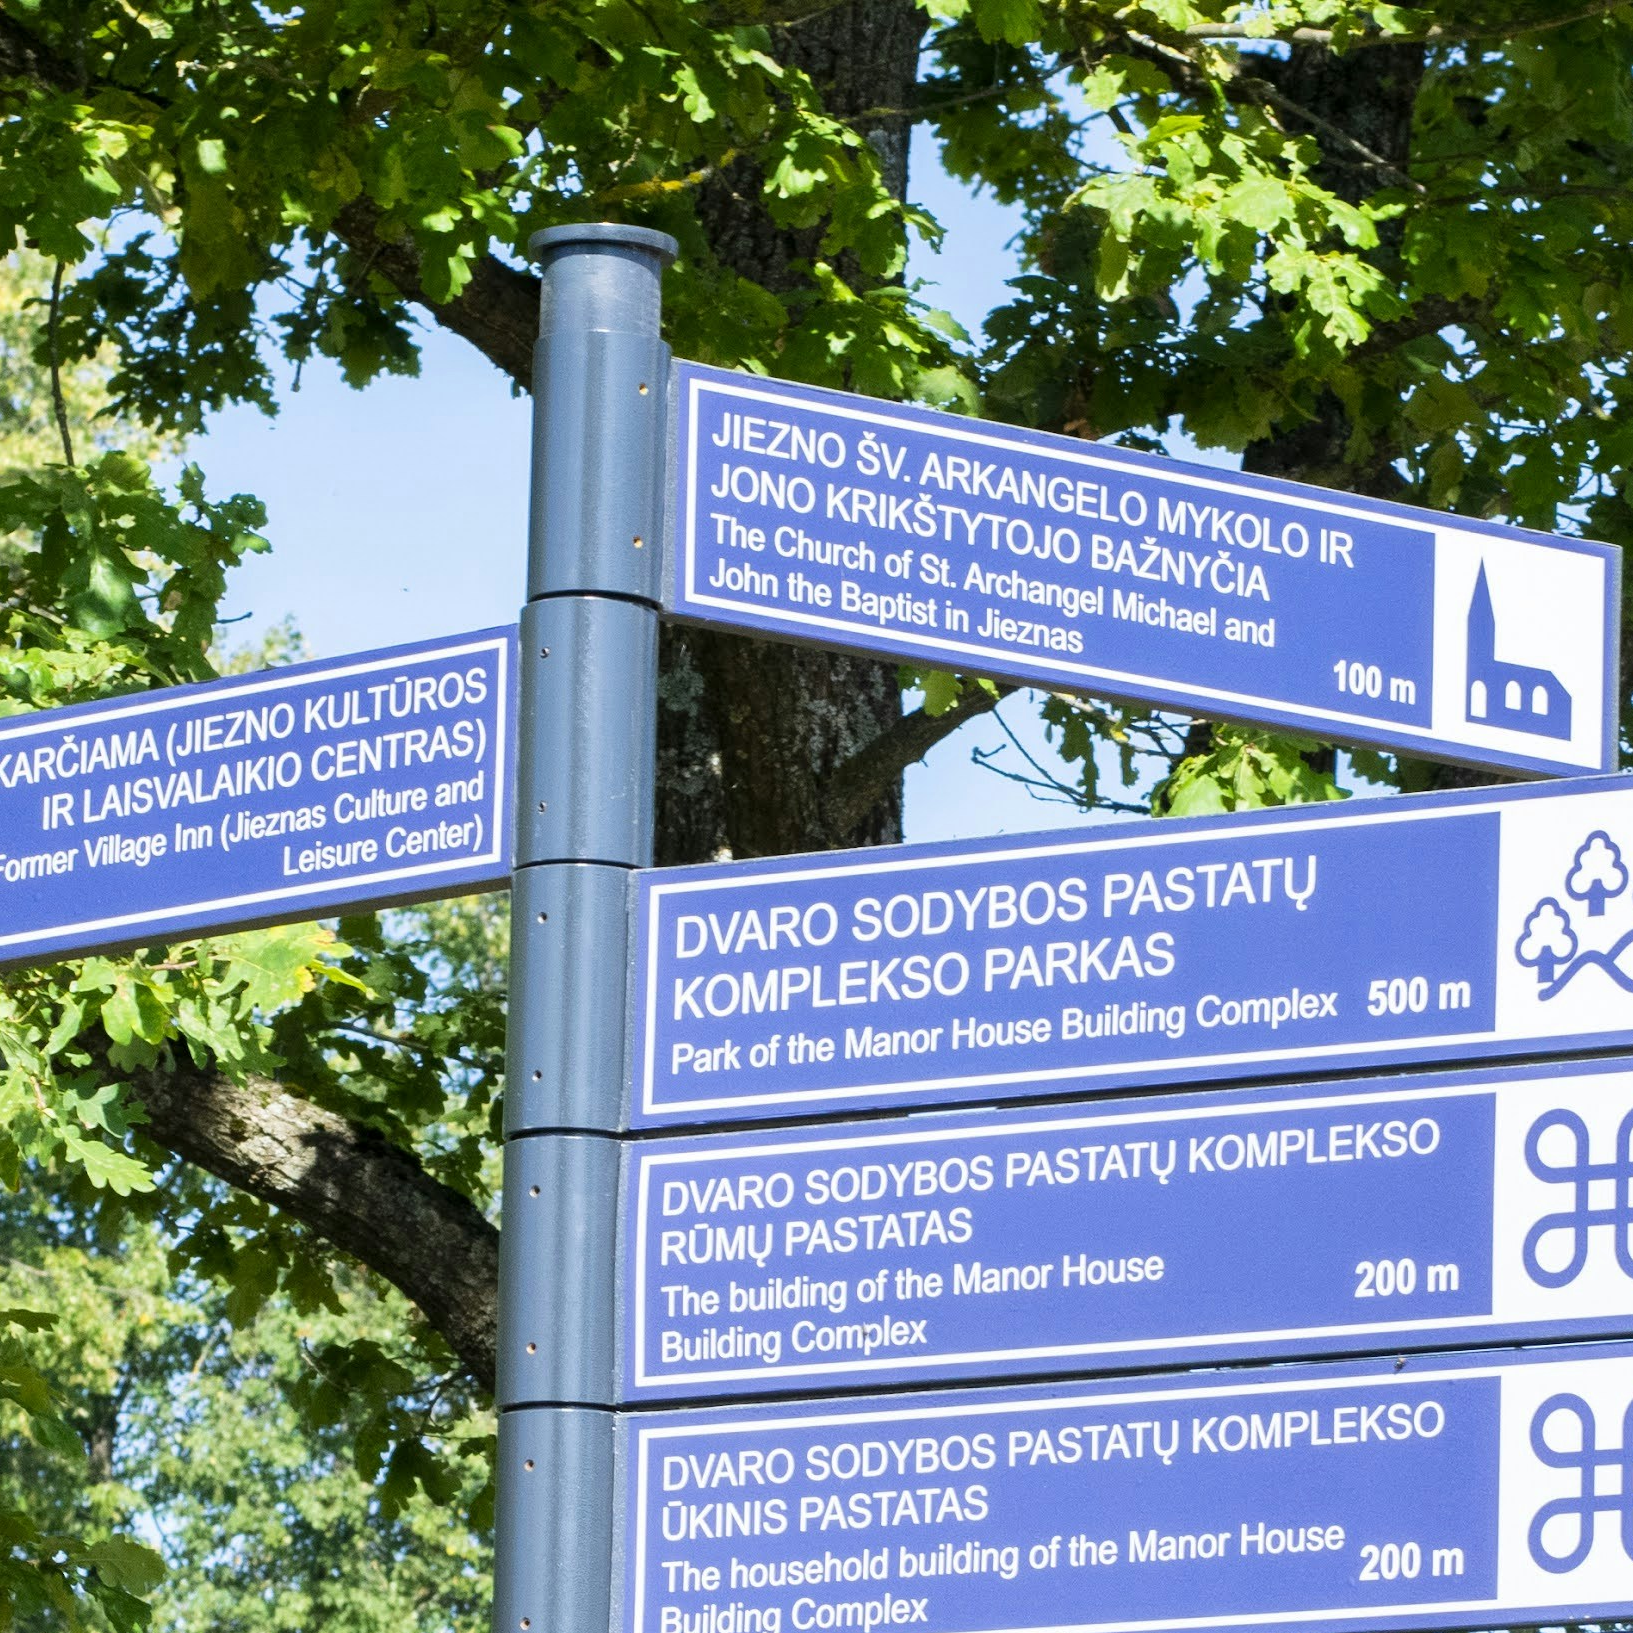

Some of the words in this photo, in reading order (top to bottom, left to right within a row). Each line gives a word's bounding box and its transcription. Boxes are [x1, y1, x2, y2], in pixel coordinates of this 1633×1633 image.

[710, 463, 816, 514] JONO
[826, 483, 1081, 564] KRIKŠTYTOJO
[1091, 533, 1270, 602] BAŽNYČIA
[711, 412, 846, 469] JIEZNO
[856, 430, 911, 483] ŠV.
[919, 452, 1148, 527] ARKANGELO
[1157, 496, 1310, 558] MYKOLO
[1320, 528, 1354, 568] IR
[709, 557, 779, 598] John
[786, 572, 832, 607] the
[841, 580, 938, 628] Baptist
[945, 600, 969, 633] in
[977, 607, 1084, 654] Jieznas
[710, 512, 766, 552] The
[774, 525, 876, 573] Church
[884, 549, 914, 580] of
[919, 552, 957, 588] St.
[963, 562, 1104, 618] Archangel
[1112, 588, 1217, 637] Michael
[1224, 617, 1275, 648] and
[166, 702, 295, 767] (JIEZNO
[304, 667, 487, 734] KULTŪROS
[1333, 659, 1383, 698] 100
[1389, 677, 1416, 705] m
[42, 792, 75, 831] IR
[83, 751, 302, 823] LAISVALAIKIO
[311, 718, 487, 782] CENTRAS)
[83, 833, 167, 868] Village
[174, 822, 213, 853] Inn
[220, 804, 327, 852] (Jieznas
[333, 787, 428, 824] Culture
[434, 769, 484, 808] and
[283, 838, 378, 876] Leisure
[385, 813, 484, 858] Center)
[676, 902, 838, 959] DVARO
[852, 877, 1088, 942] SODYBOS
[1103, 855, 1317, 918] PASTATŲ
[673, 951, 970, 1021] KOMPLEKSO
[984, 931, 1175, 992] PARKAS
[1367, 976, 1429, 1017] 500
[1438, 980, 1471, 1010] m
[671, 1039, 741, 1075] Park
[749, 1034, 782, 1068] of
[786, 1032, 835, 1065] the
[844, 1026, 944, 1060] Manor
[952, 1017, 1052, 1050] House
[1061, 1001, 1186, 1040] Building
[1196, 987, 1338, 1030] Complex
[662, 1172, 795, 1217] DVARO
[804, 1154, 994, 1205] SODYBOS
[1005, 1139, 1176, 1188] PASTATŲ
[1189, 1117, 1441, 1173] KOMPLEKSO
[660, 1223, 773, 1268] RŪMŲ
[785, 1207, 973, 1257] PASTATAS
[1354, 1257, 1417, 1298] 200
[1427, 1263, 1459, 1293] m
[660, 1284, 720, 1318] The
[729, 1275, 848, 1314] building
[856, 1269, 889, 1303] of
[894, 1267, 944, 1300] the
[953, 1261, 1054, 1296] Manor
[1062, 1253, 1165, 1287] House
[661, 1325, 782, 1364] Building
[791, 1314, 927, 1356] Complex
[663, 1447, 795, 1492] DVARO
[805, 1433, 996, 1481] SODYBOS
[1008, 1419, 1179, 1467] PASTATŲ
[1192, 1400, 1445, 1454] KOMPLEKSO
[662, 1498, 788, 1542] ŪKINIS
[799, 1484, 989, 1532] PASTATAS
[661, 1560, 721, 1593] The
[730, 1547, 889, 1589] household
[899, 1541, 1019, 1580] building
[1029, 1535, 1062, 1570] of
[1067, 1534, 1118, 1567] the
[1128, 1529, 1232, 1563] Manor
[1240, 1522, 1345, 1556] House
[1359, 1541, 1421, 1581] 200
[1432, 1547, 1464, 1577] m
[791, 1592, 928, 1633] Complex
